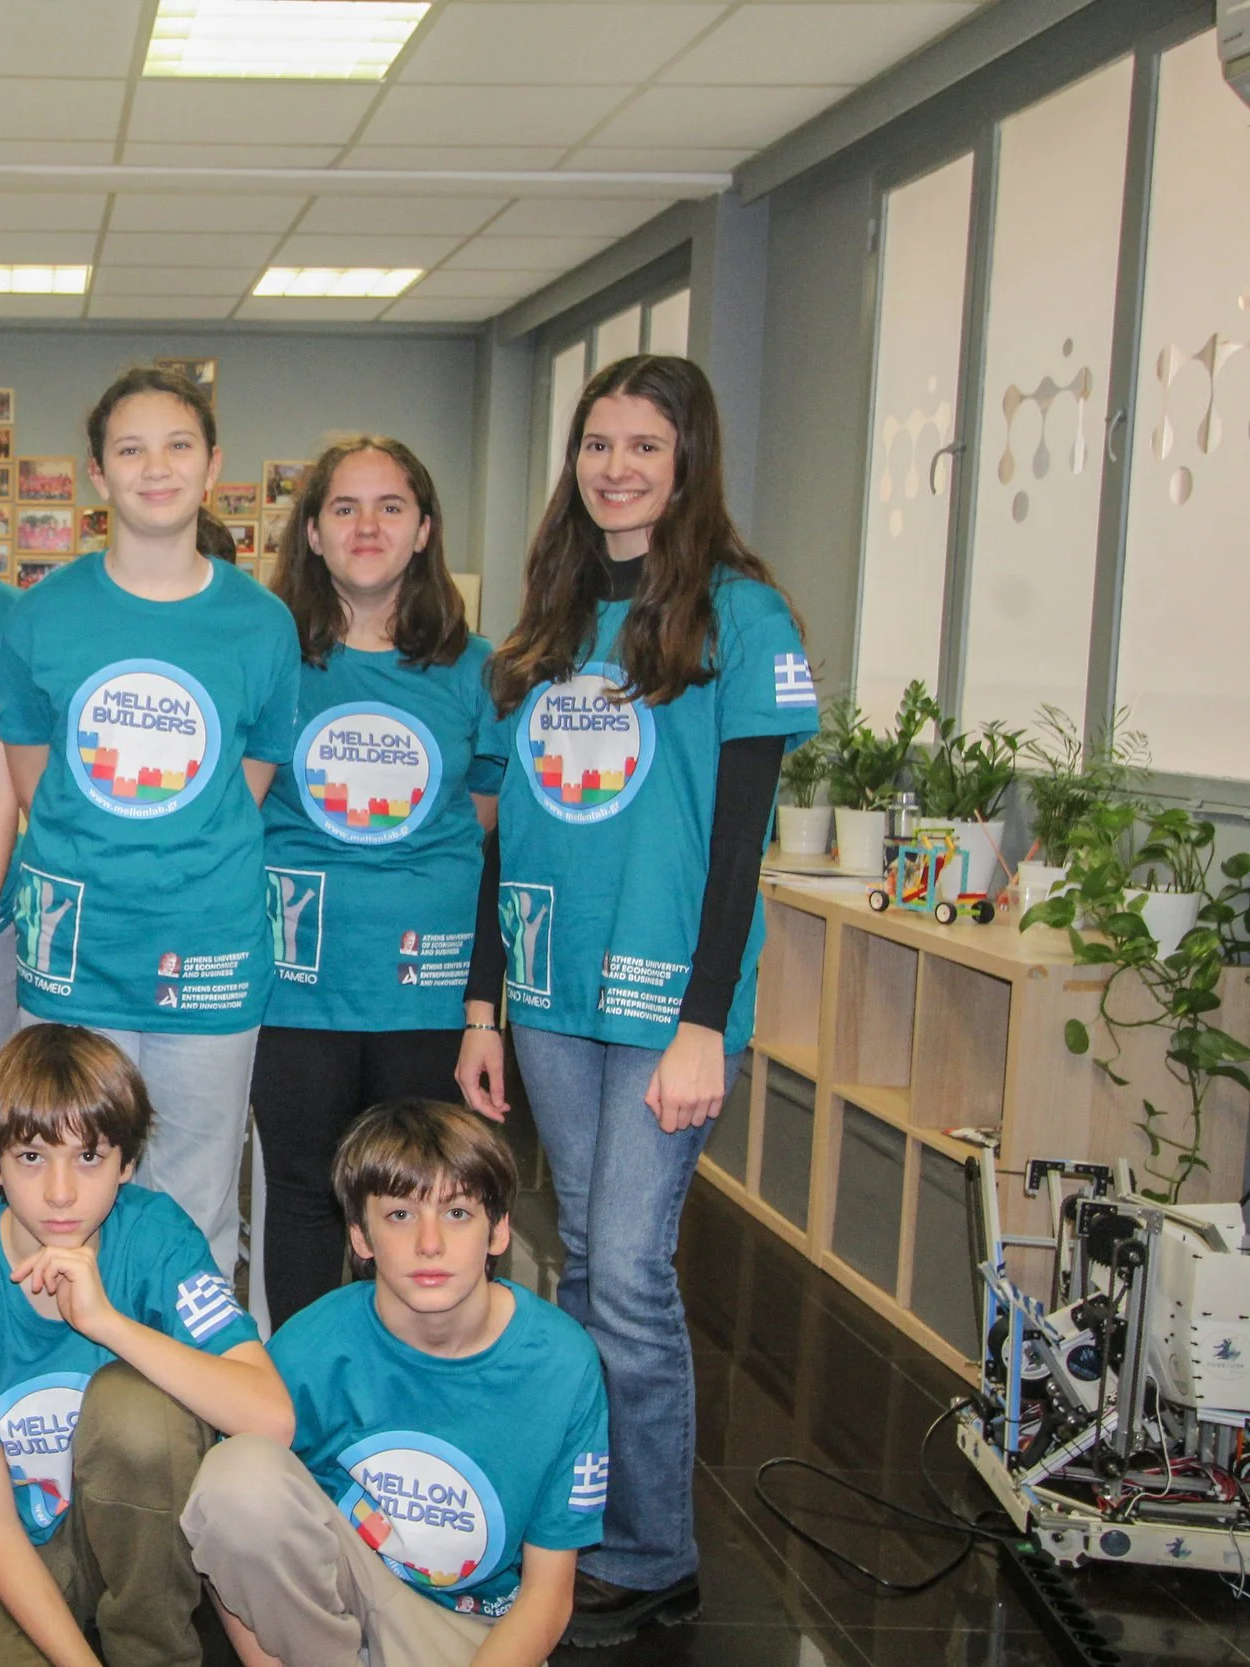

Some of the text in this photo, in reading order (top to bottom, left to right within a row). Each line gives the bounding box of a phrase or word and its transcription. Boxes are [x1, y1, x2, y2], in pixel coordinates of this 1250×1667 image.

[103, 689, 191, 717] MELLON
[546, 696, 621, 713] MELLON
[92, 707, 197, 735] BUILDERS
[540, 713, 630, 732] BUILDERS
[328, 729, 411, 749] MELLON
[319, 745, 420, 766] BUILDERS
[88, 788, 179, 817] www.mellonlab.gr
[183, 963, 194, 971] OF
[184, 955, 213, 964] ATHENS
[611, 954, 690, 974] ATHENS UNIVERSITY
[182, 970, 200, 978] AND
[279, 968, 318, 985] ΤΑΜΕΙΟ
[608, 971, 664, 987] AND BUSINESS
[610, 963, 671, 980] OF ECONOMICS
[34, 976, 71, 996] ΤΑΜΕΙΟ
[607, 987, 640, 998] ATHENS
[640, 992, 666, 1004] CENTER
[181, 1001, 199, 1009] AND
[605, 1005, 671, 1024] AND INNOVATION
[7, 1411, 80, 1438] MELLO
[2, 1434, 71, 1457] BUILD
[362, 1467, 468, 1509] MELLON
[377, 1493, 475, 1533] ILDERS
